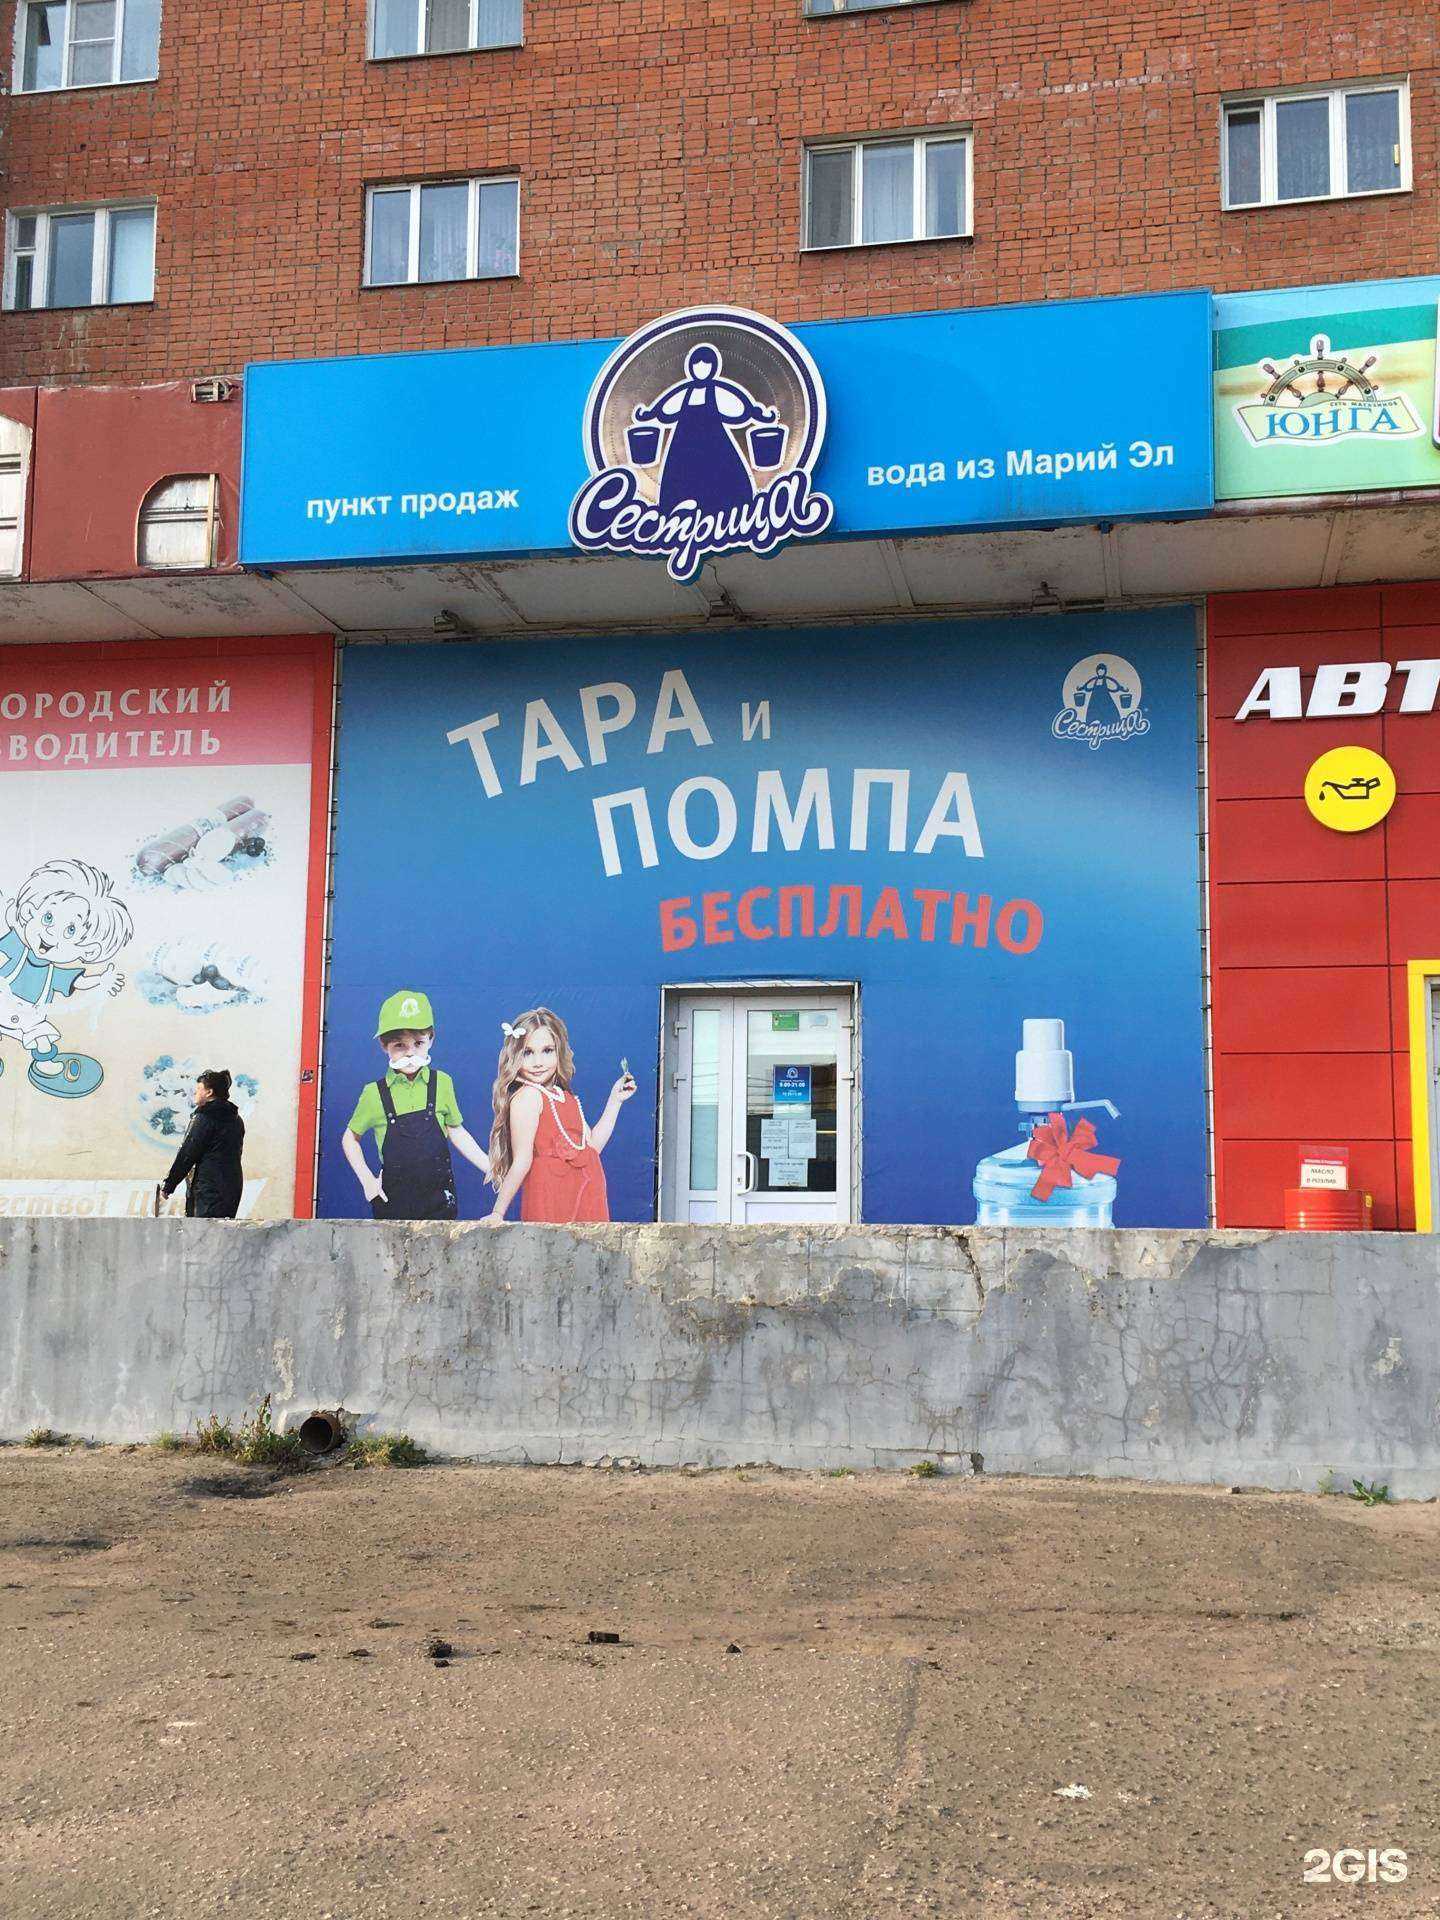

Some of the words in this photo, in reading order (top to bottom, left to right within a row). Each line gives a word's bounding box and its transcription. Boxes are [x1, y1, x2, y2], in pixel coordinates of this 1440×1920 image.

[1265, 407, 1401, 437] ЮНГА
[867, 461, 946, 488] вода
[956, 457, 995, 480] из
[1006, 442, 1117, 480] Марий
[1128, 440, 1174, 469] Эл
[306, 495, 392, 524] пункт
[401, 489, 520, 519] продаж
[572, 470, 825, 572] Сестрица
[0, 679, 231, 721] ОРОДСКИЙ
[1234, 658, 1440, 722] АВТ
[8, 729, 221, 764] ВОДИТЕЛЬ
[446, 669, 714, 799] ТАРА
[1053, 708, 1149, 748] Сестрица
[592, 767, 984, 877] ПОМПА
[659, 884, 1044, 955] БЕСПЛАТНО
